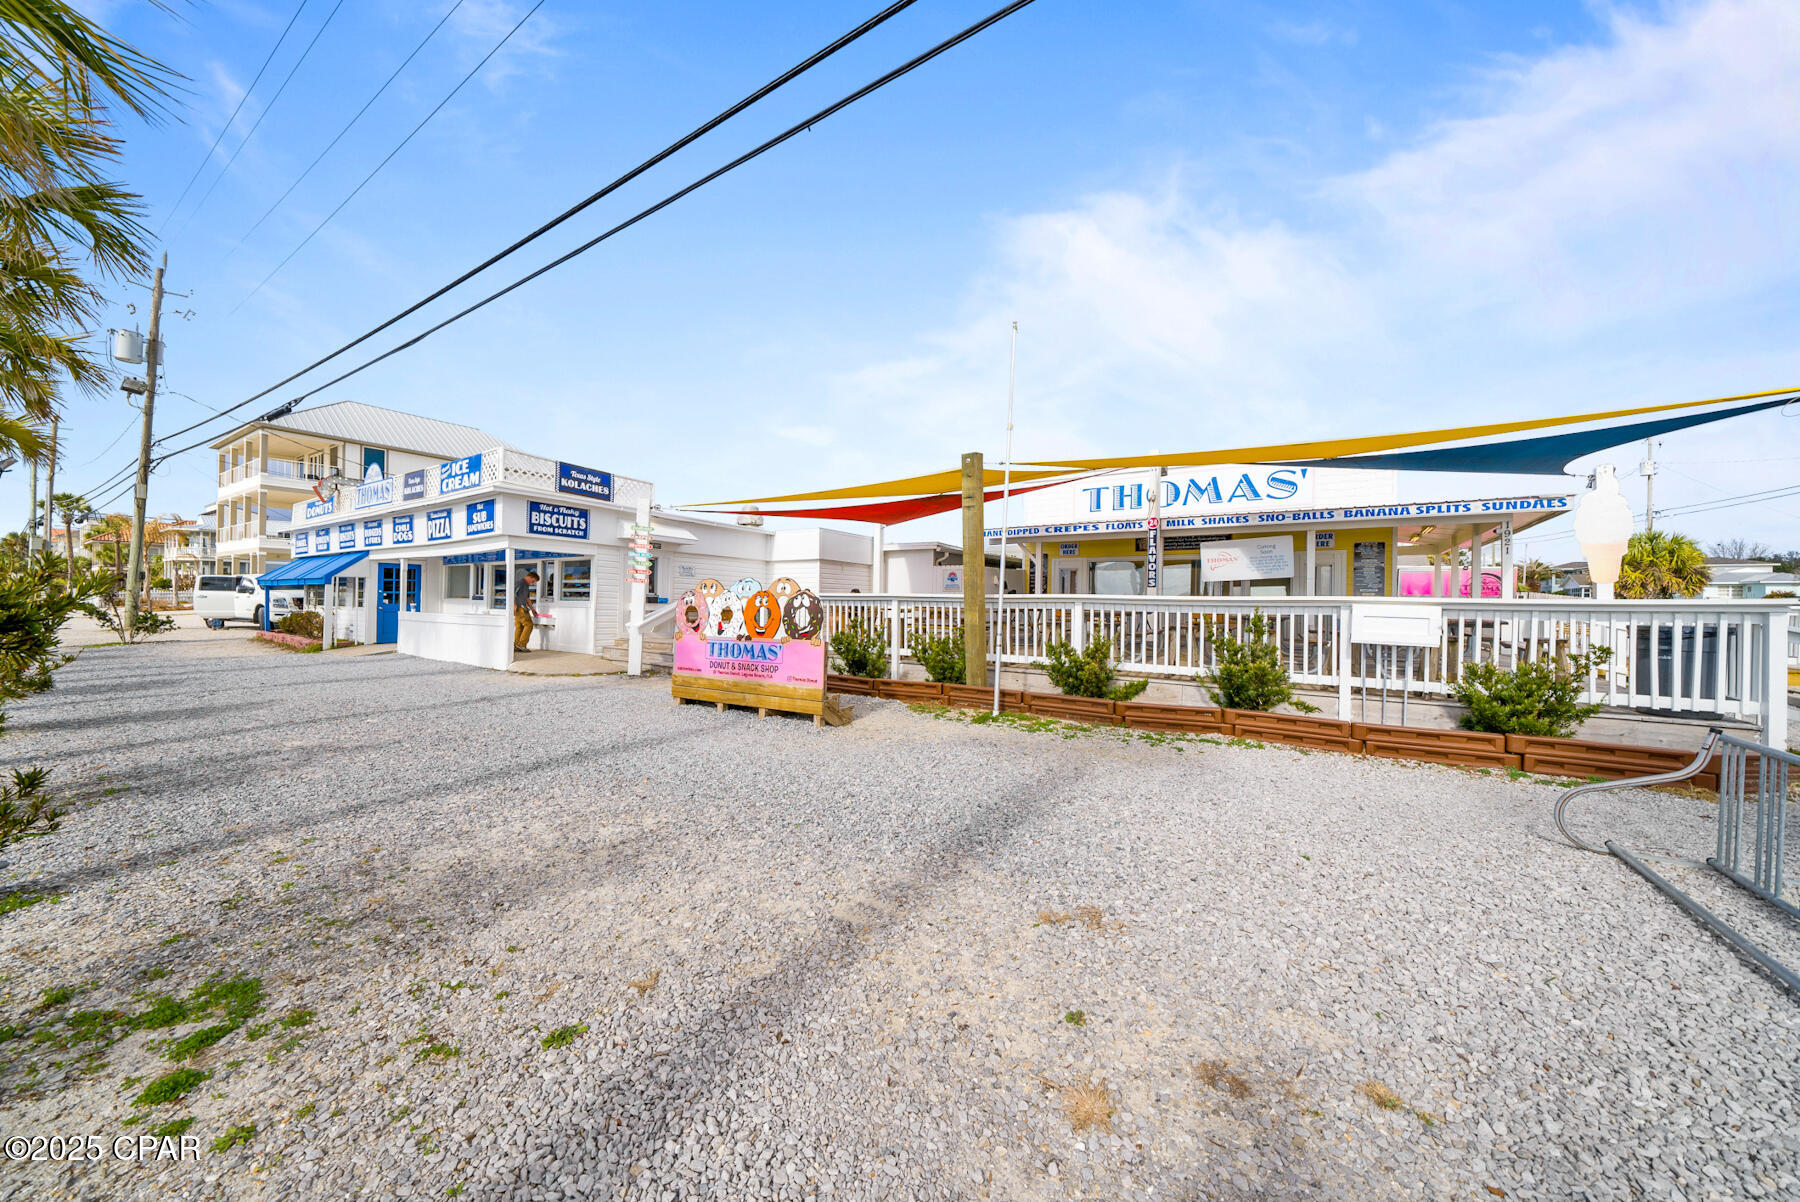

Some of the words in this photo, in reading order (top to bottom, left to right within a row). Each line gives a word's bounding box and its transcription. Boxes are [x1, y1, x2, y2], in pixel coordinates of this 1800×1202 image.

[451, 459, 469, 476] ICE
[442, 472, 479, 492] CREAM
[570, 470, 586, 480] Texas
[587, 474, 601, 483] Style
[561, 478, 609, 494] KOLACHES
[1082, 468, 1308, 512] THOMAS'
[306, 502, 332, 518] DONUTS
[472, 511, 487, 523] SUB
[1166, 518, 1195, 528] MILK
[1201, 514, 1250, 525] SHAKES
[1258, 510, 1334, 522] SNO-BALLS
[1344, 506, 1410, 518] BANANA
[1416, 503, 1472, 515] SPLITS
[1481, 498, 1568, 512] SUNDAES
[428, 518, 450, 538] PIZZA
[531, 511, 586, 530] BISCUITS
[393, 531, 412, 542] DOGS
[555, 527, 584, 536] SCRATCH
[1008, 528, 1040, 536] DIPPED
[1045, 524, 1100, 533] CREPES
[1106, 522, 1143, 530] FLOATS
[1148, 530, 1156, 586] FLAVORS
[707, 641, 782, 661] THOMAS'
[710, 660, 730, 670] DONUT
[738, 662, 760, 672] SNACK
[760, 664, 778, 674] SHOP
